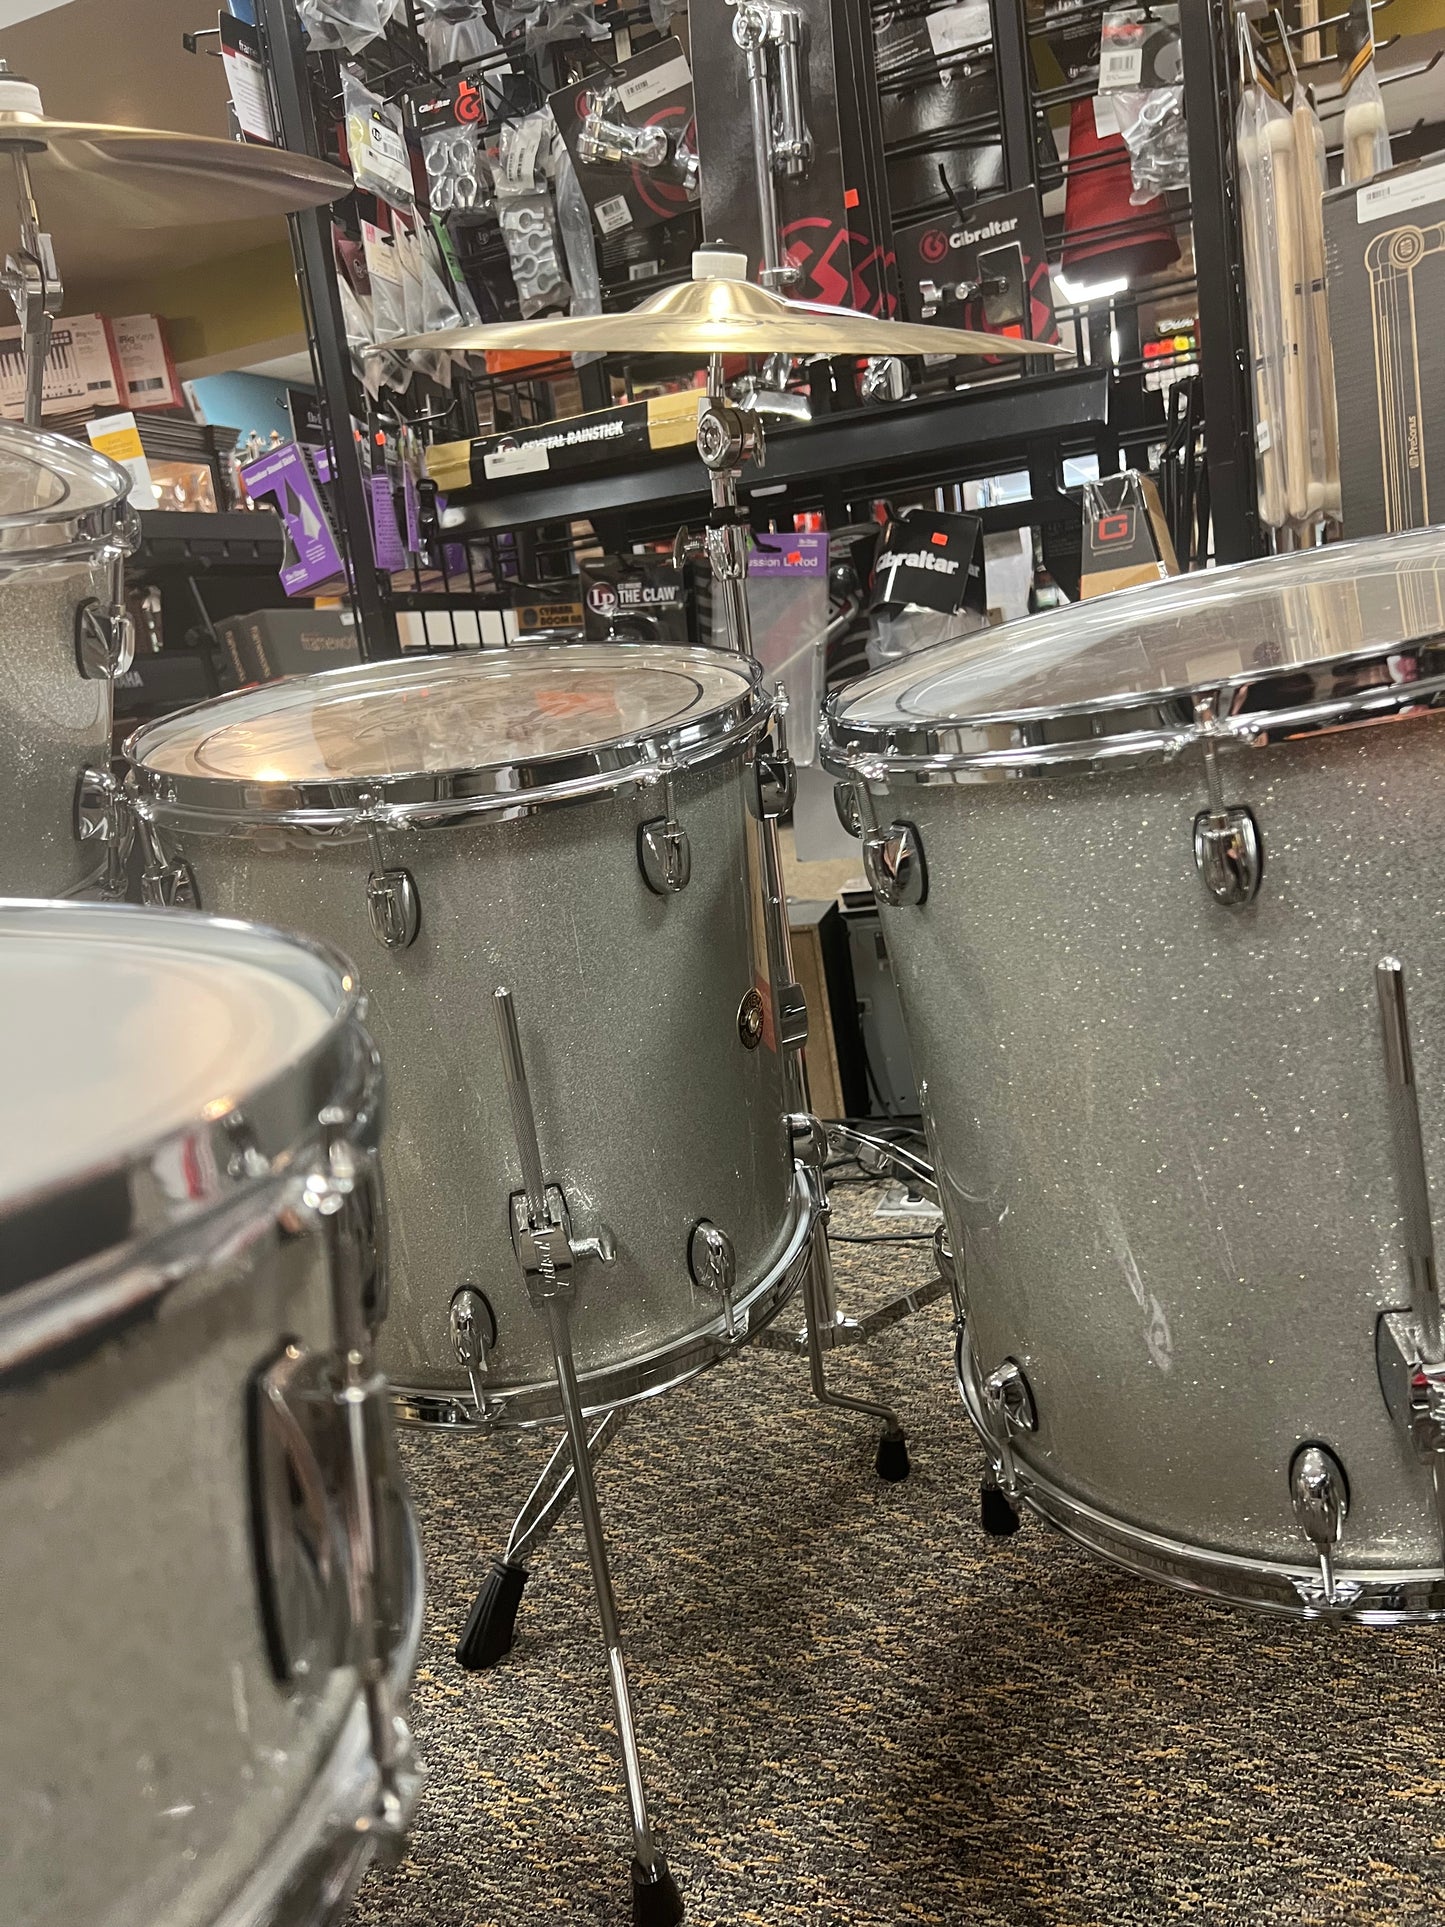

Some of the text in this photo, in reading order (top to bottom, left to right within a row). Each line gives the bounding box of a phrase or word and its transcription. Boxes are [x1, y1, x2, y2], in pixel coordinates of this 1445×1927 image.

[948, 217, 1018, 249] Gibraltar
[566, 420, 624, 446] RAINSTICK
[1408, 415, 1418, 456] PreSonus
[618, 589, 641, 604] THE
[642, 586, 676, 602] CLAW
